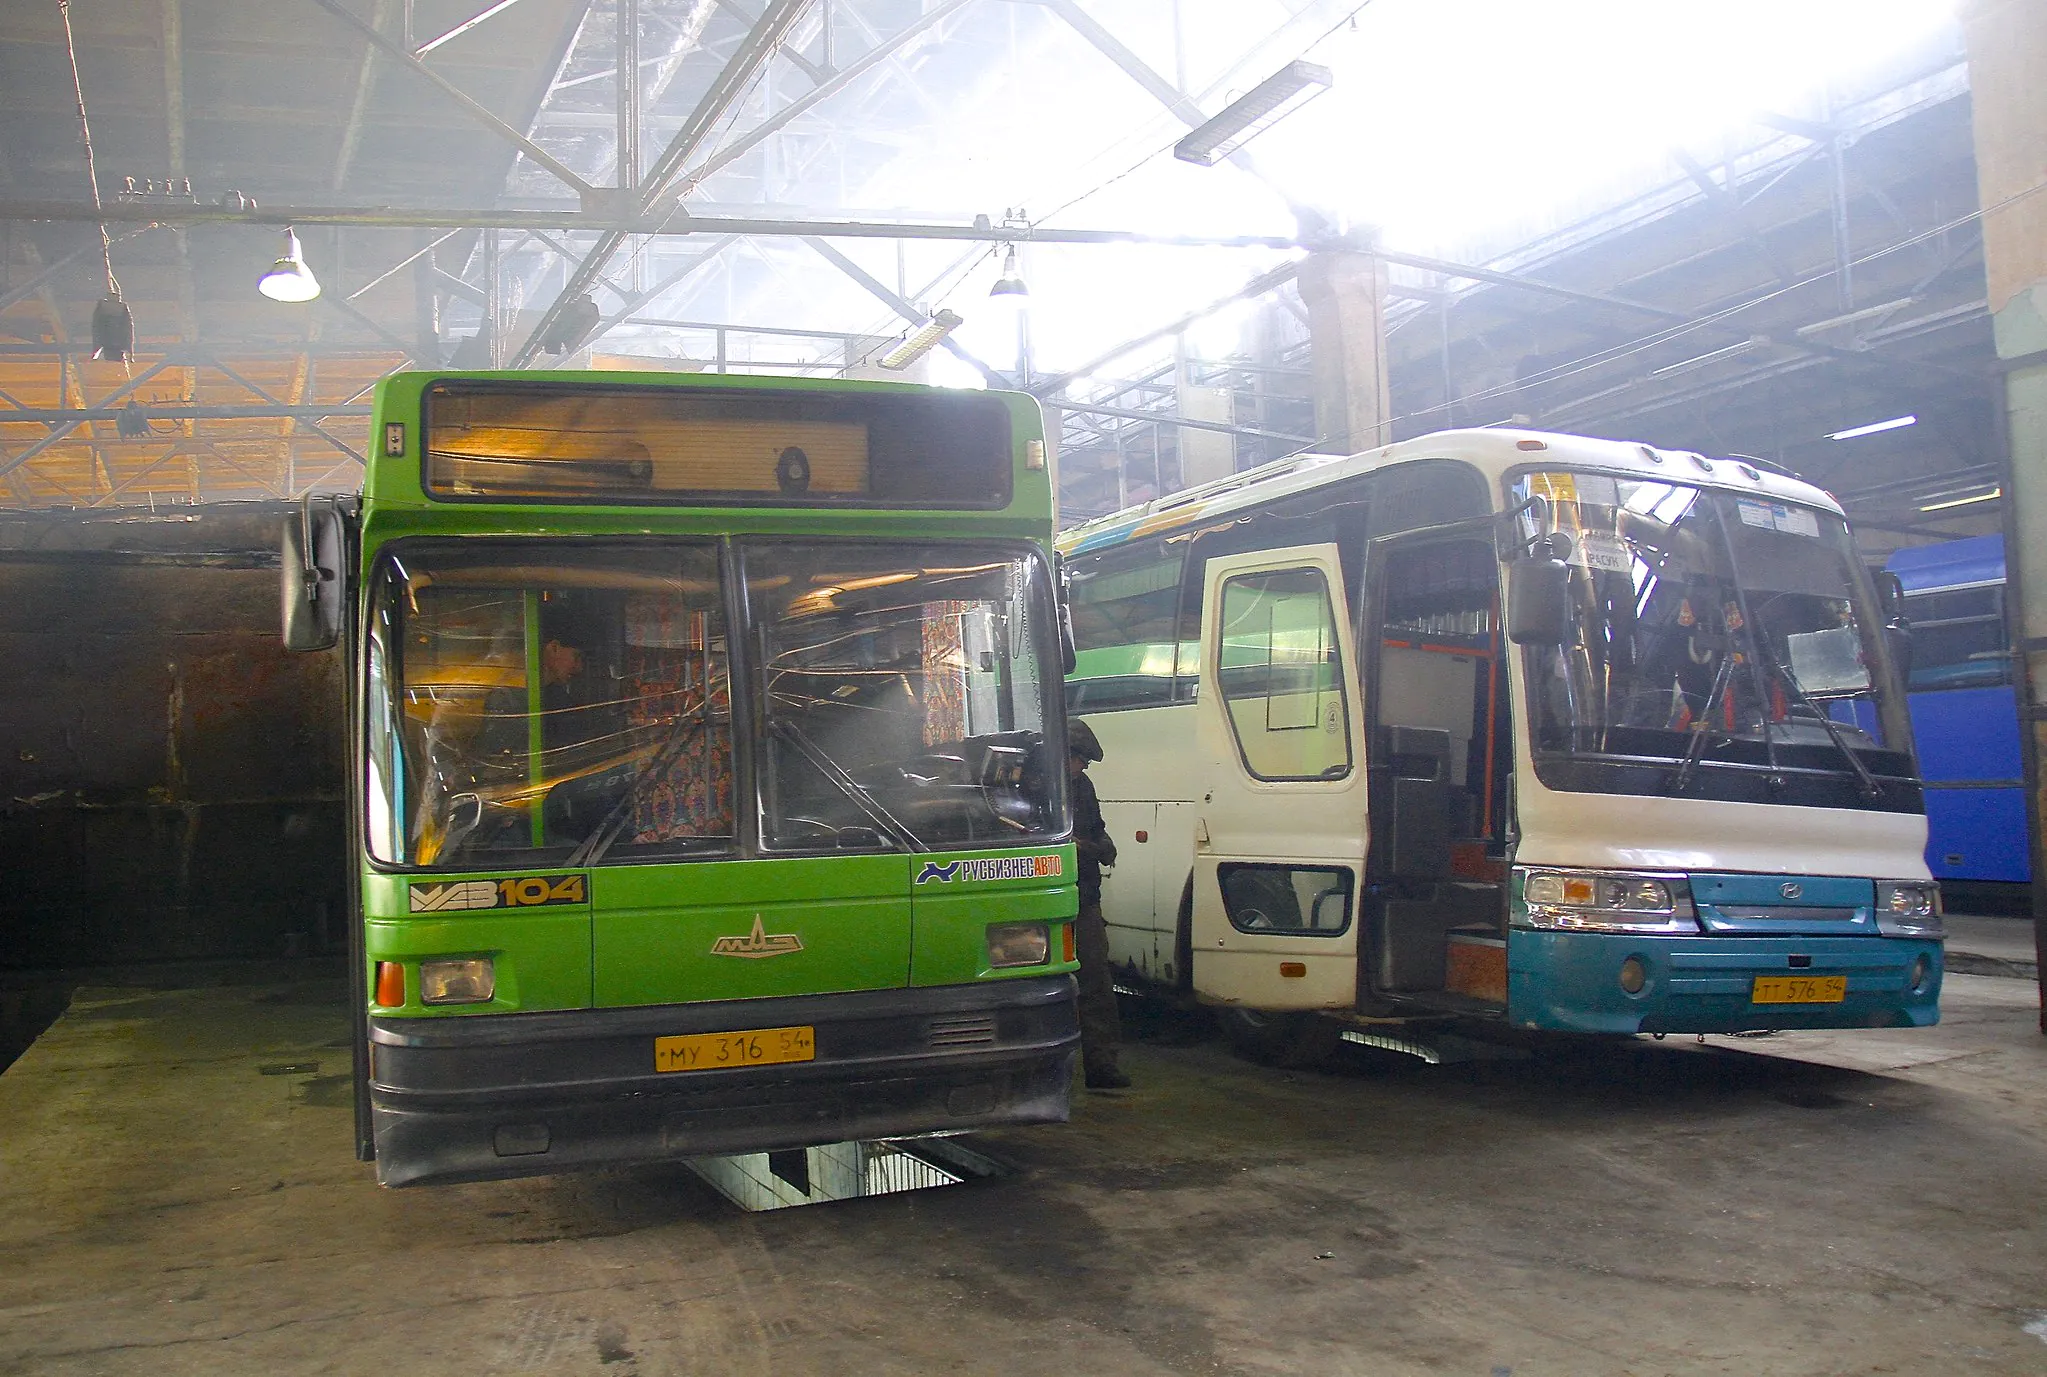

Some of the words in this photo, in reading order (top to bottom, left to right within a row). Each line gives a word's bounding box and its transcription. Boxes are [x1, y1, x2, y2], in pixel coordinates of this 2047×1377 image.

[962, 855, 1061, 881] РУСБИЗНЕСАВТО
[1786, 980, 1817, 1000] 576
[715, 1035, 763, 1062] 316
[779, 1030, 804, 1050] 54
